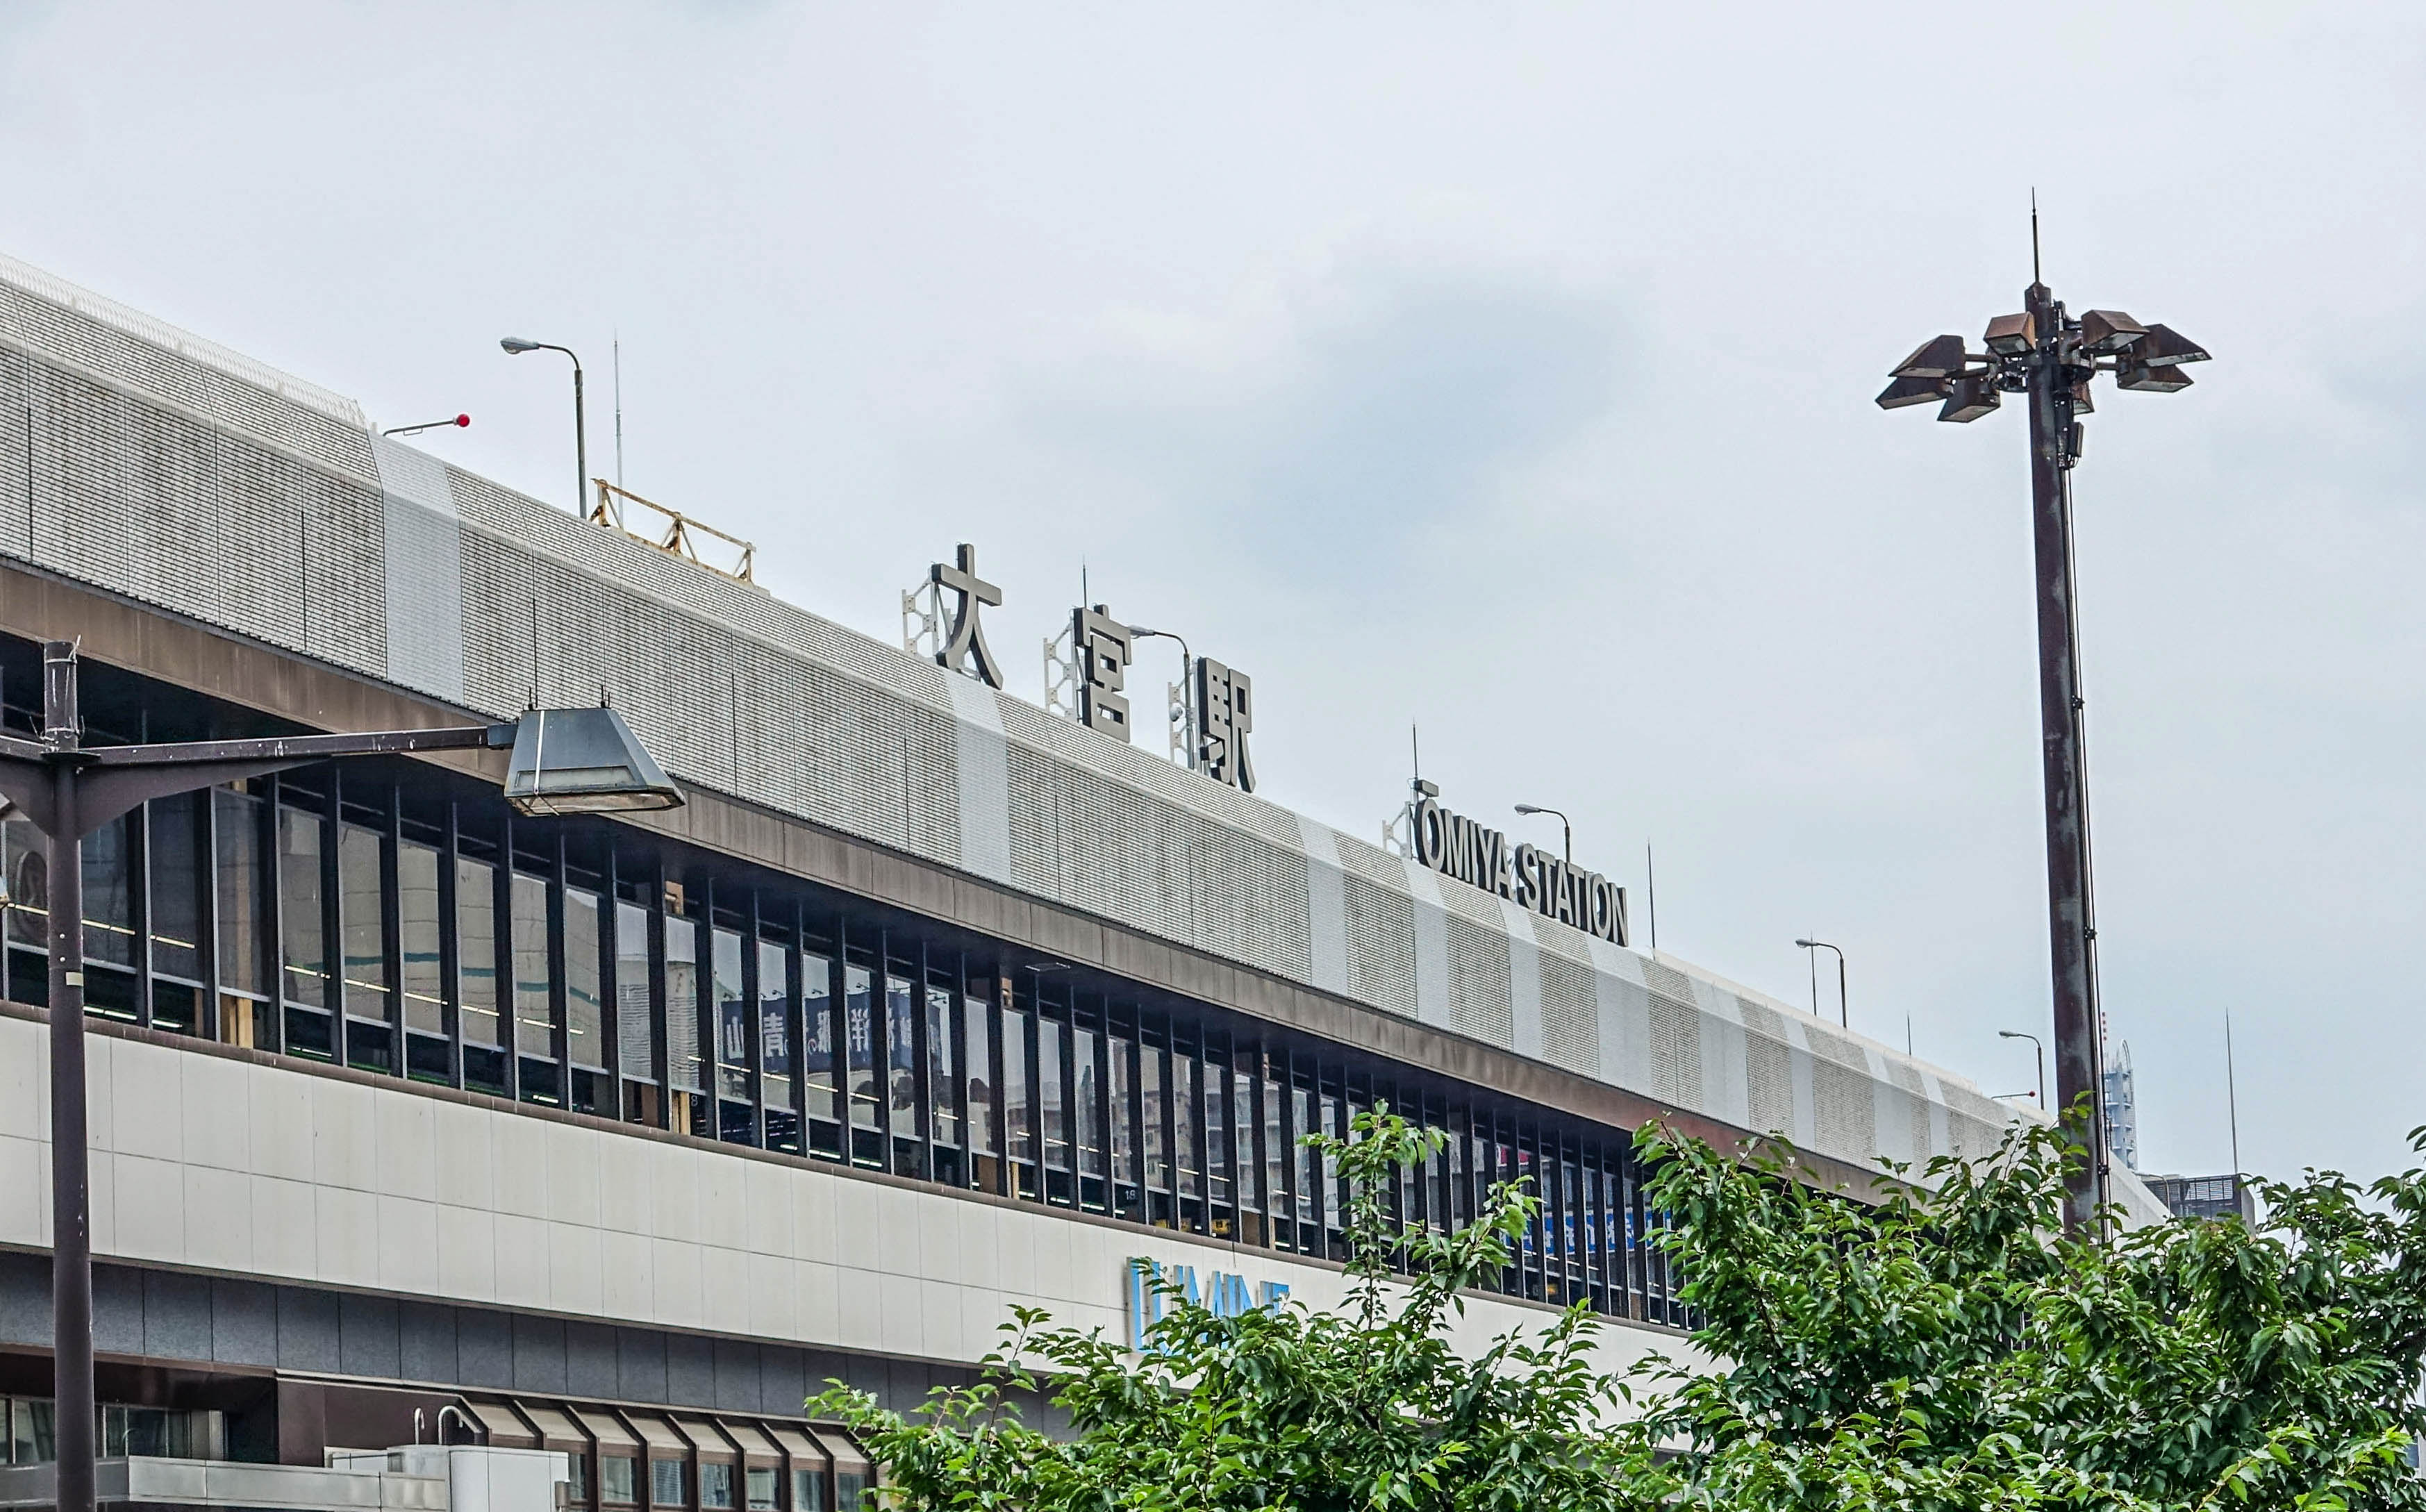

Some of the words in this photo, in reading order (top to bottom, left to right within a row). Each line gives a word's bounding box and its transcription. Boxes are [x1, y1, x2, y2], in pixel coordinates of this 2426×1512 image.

[931, 543, 1256, 793] 大宮駅
[1515, 842, 1629, 947] STATION
